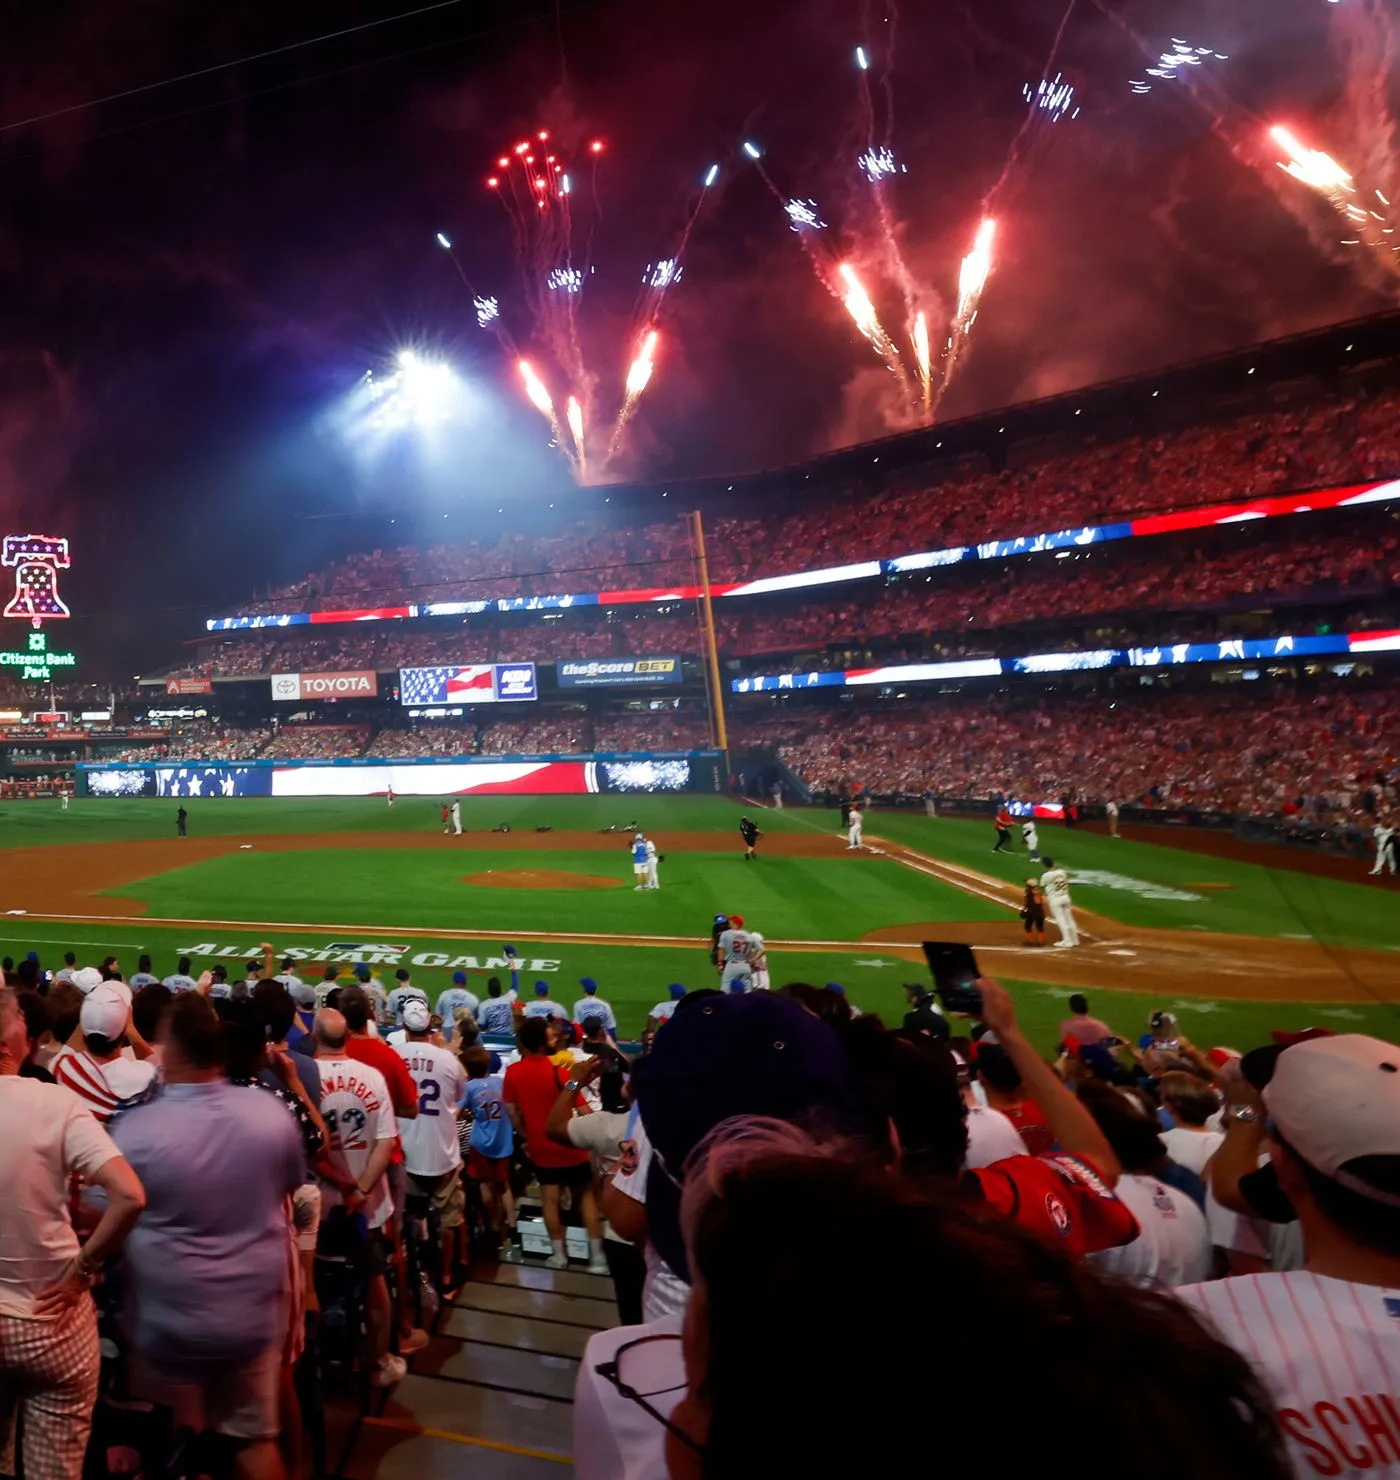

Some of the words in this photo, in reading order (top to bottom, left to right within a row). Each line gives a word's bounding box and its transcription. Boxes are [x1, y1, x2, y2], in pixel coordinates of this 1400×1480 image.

[46, 652, 75, 665] Bank
[24, 665, 50, 678] Park
[562, 662, 635, 676] theScore
[639, 661, 671, 672] BET
[303, 677, 371, 692] TOYOTA
[282, 947, 403, 965] STAR
[411, 952, 562, 972] GAME
[404, 1057, 434, 1073] SOTO
[419, 1078, 441, 1117] 2
[1278, 1393, 1400, 1477] SCH
